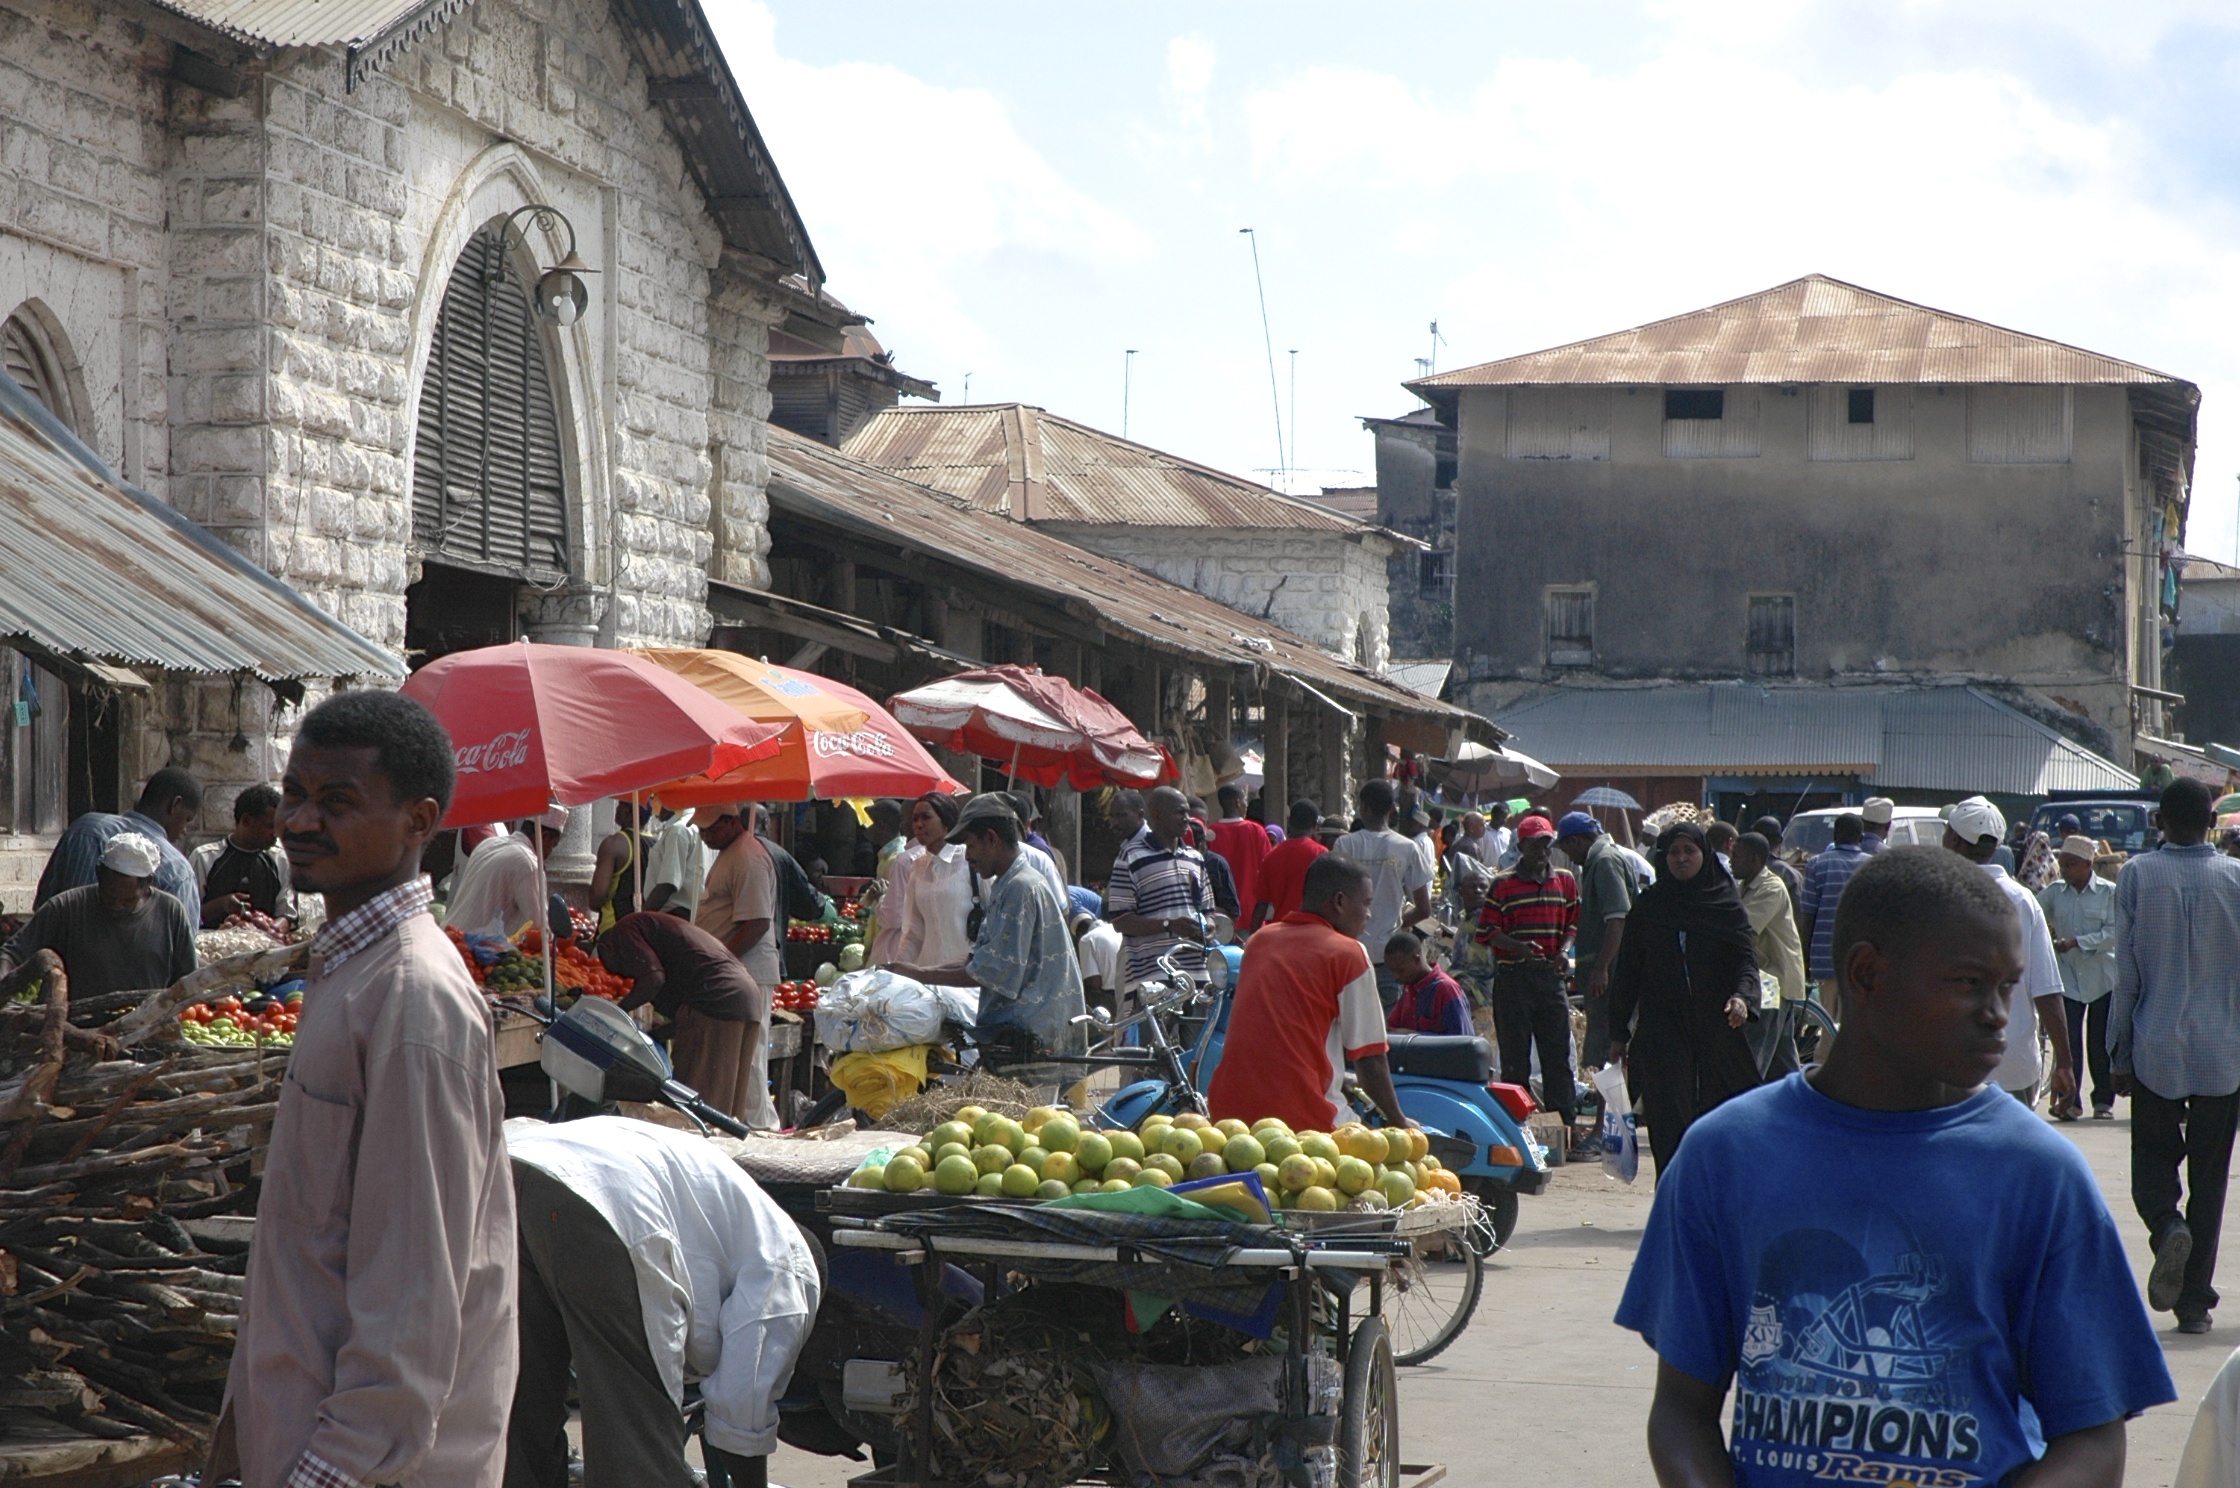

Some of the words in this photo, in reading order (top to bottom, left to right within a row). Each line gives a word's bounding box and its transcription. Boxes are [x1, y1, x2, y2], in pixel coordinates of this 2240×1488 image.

[450, 728, 531, 774] ca-Cola
[1755, 1448, 1819, 1472] LOUIS
[1814, 1452, 1982, 1488] Rams
